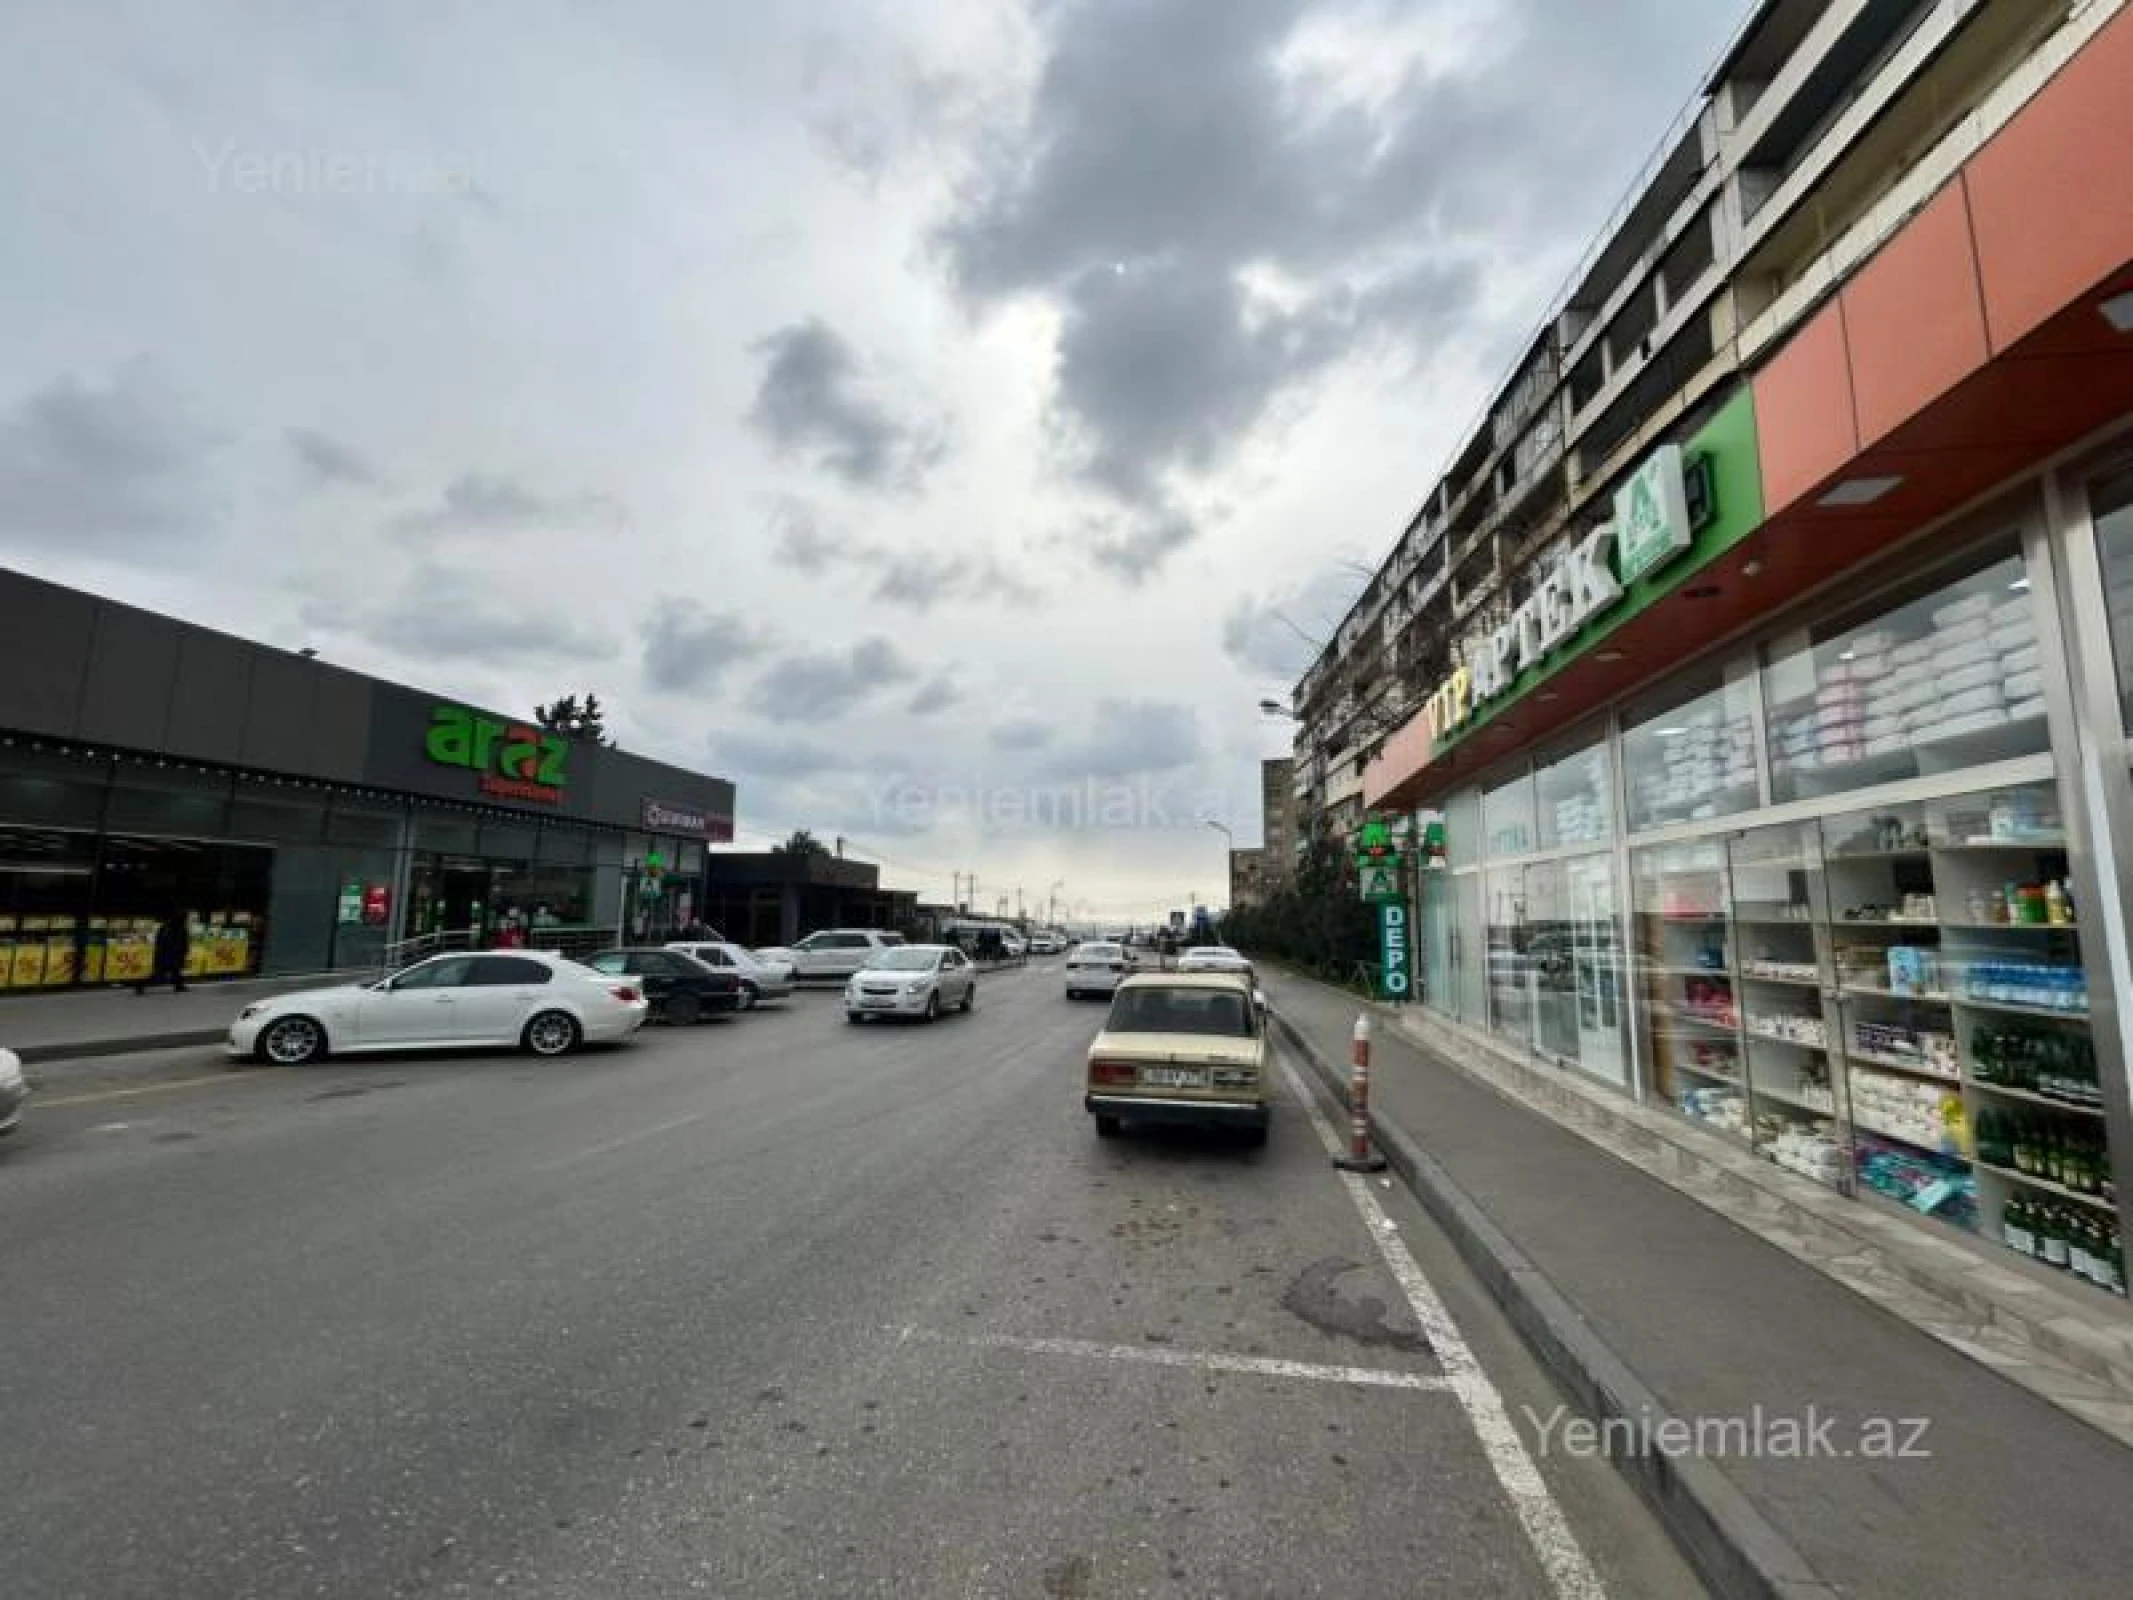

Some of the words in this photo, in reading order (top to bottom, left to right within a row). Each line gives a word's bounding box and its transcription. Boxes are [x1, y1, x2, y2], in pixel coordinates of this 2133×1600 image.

[1428, 665, 1474, 740] VIP
[1466, 521, 1625, 708] APTEK
[426, 706, 572, 785] araz
[1385, 905, 1408, 993] DEPO
